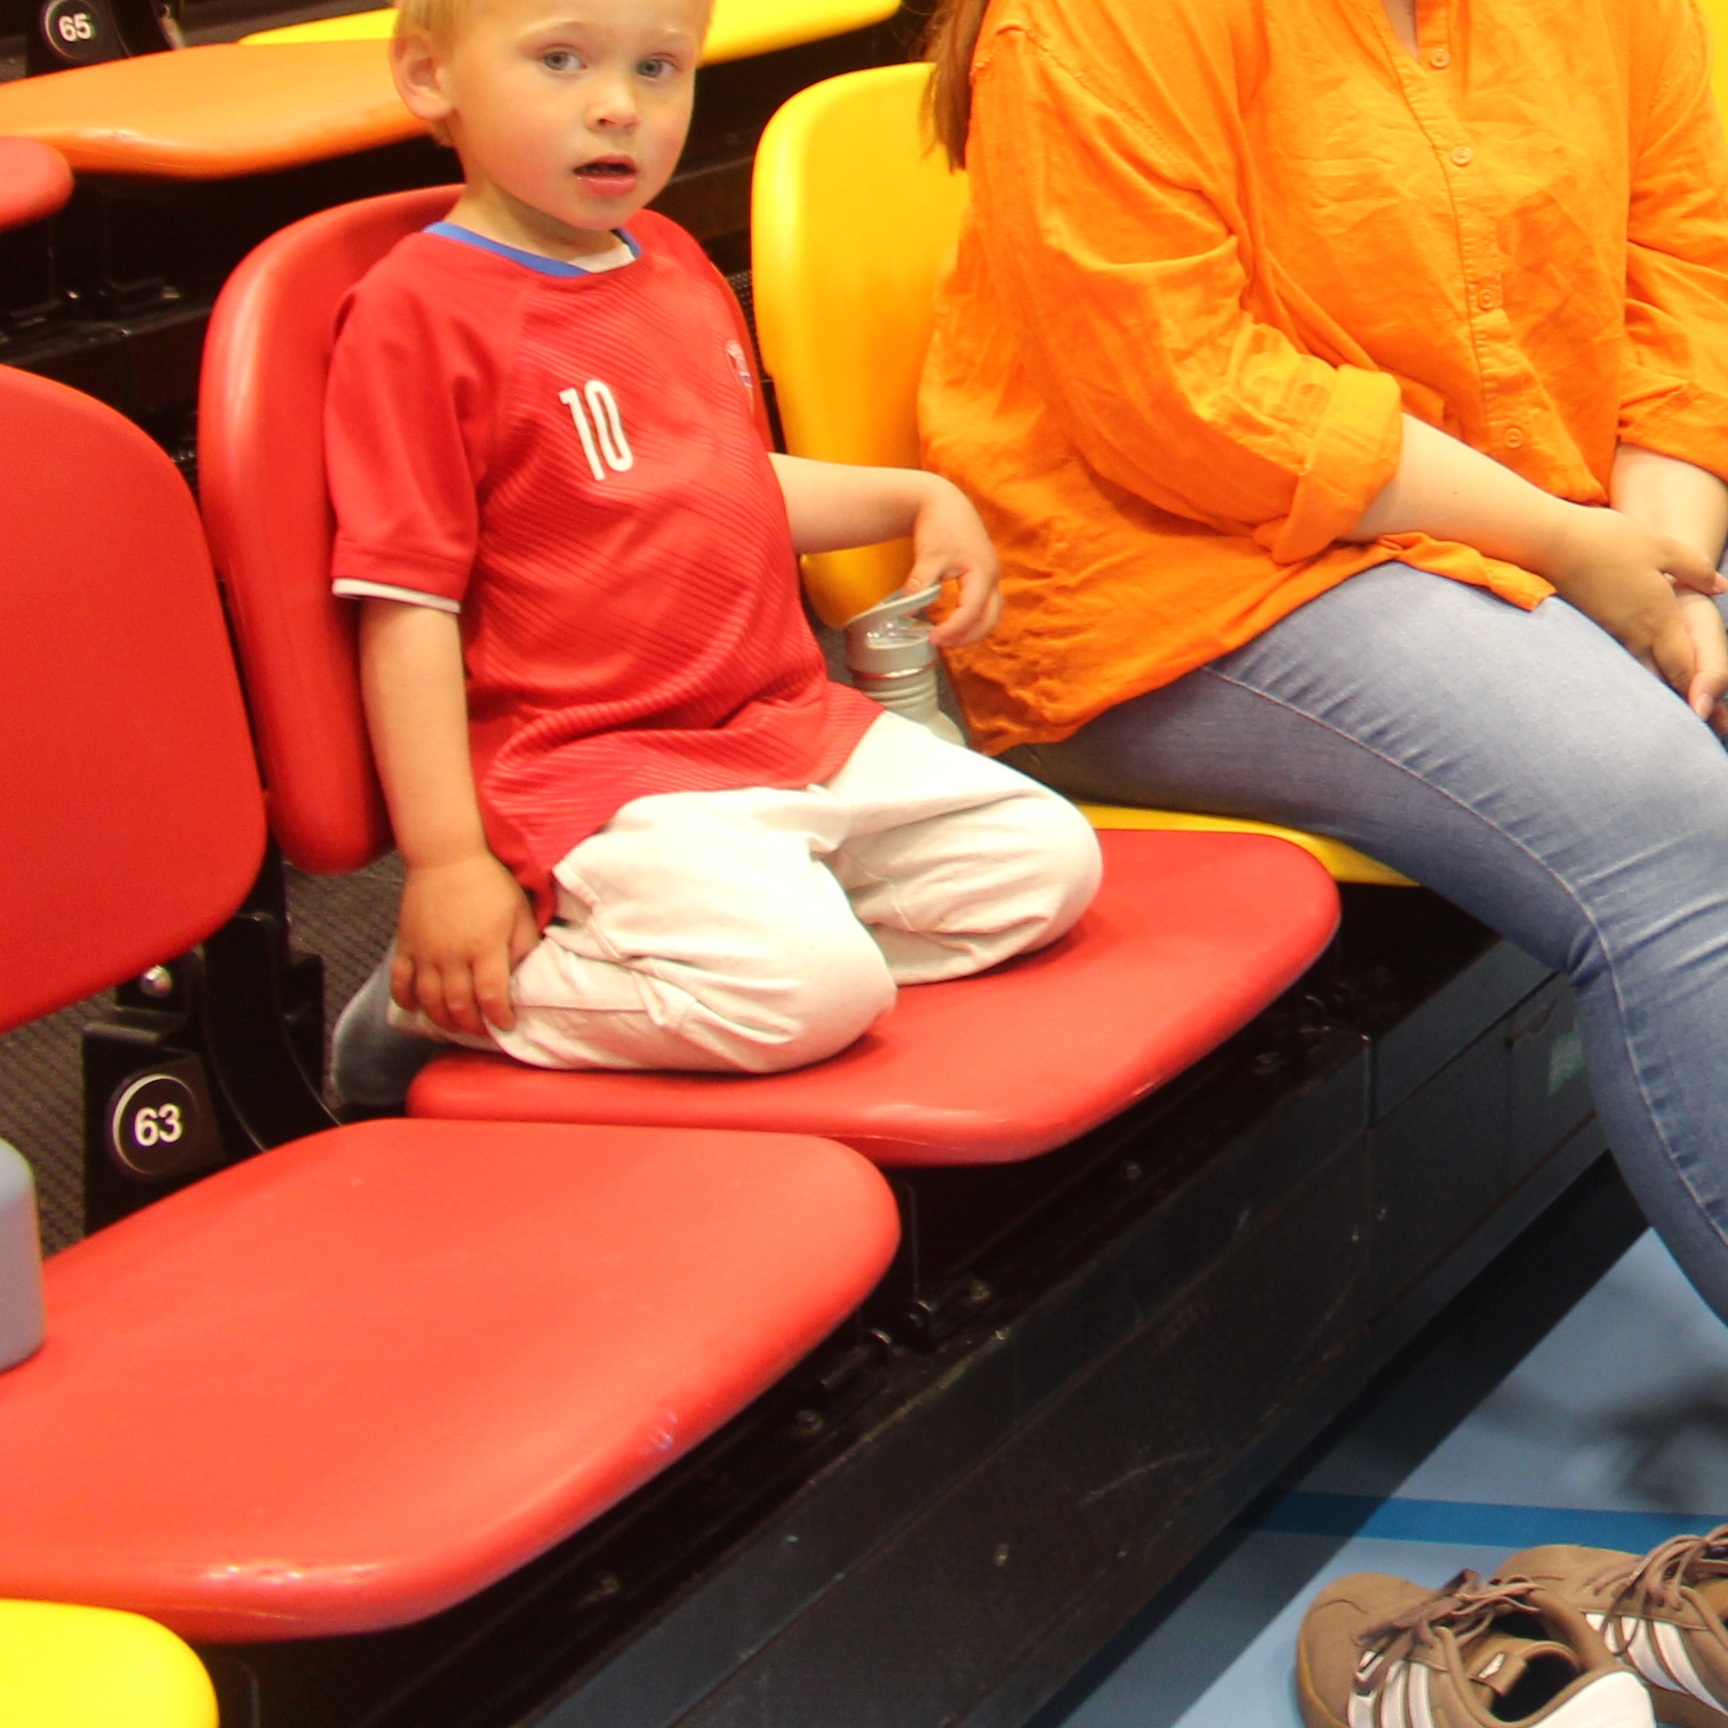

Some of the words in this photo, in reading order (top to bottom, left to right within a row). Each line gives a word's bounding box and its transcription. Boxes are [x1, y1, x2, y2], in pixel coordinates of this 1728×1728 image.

[58, 12, 93, 42] 65
[558, 380, 634, 481] 10
[134, 1102, 183, 1147] 63
